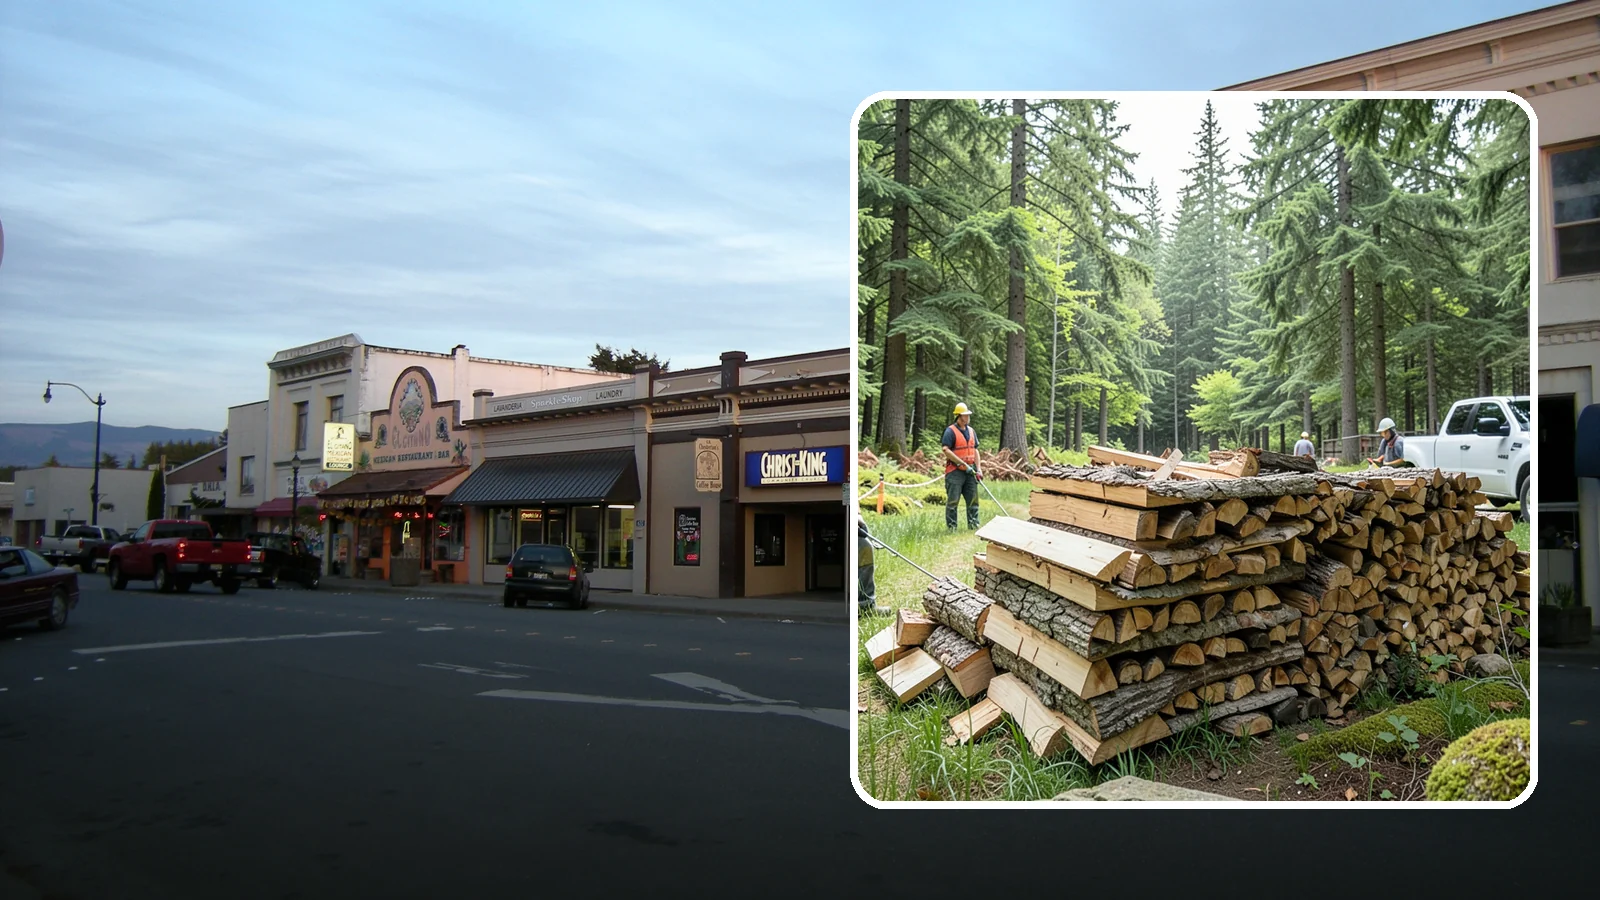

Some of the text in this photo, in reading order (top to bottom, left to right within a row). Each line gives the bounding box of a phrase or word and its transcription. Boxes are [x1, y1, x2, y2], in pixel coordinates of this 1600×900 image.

[595, 389, 623, 400] LAUNDRY
[493, 402, 522, 412] LAVANDERIA
[374, 454, 396, 464] MEXICAN
[397, 451, 433, 462] RESTAURANT
[438, 450, 450, 459] BAR
[761, 450, 827, 478] CHRIST KING
[710, 480, 722, 488] House
